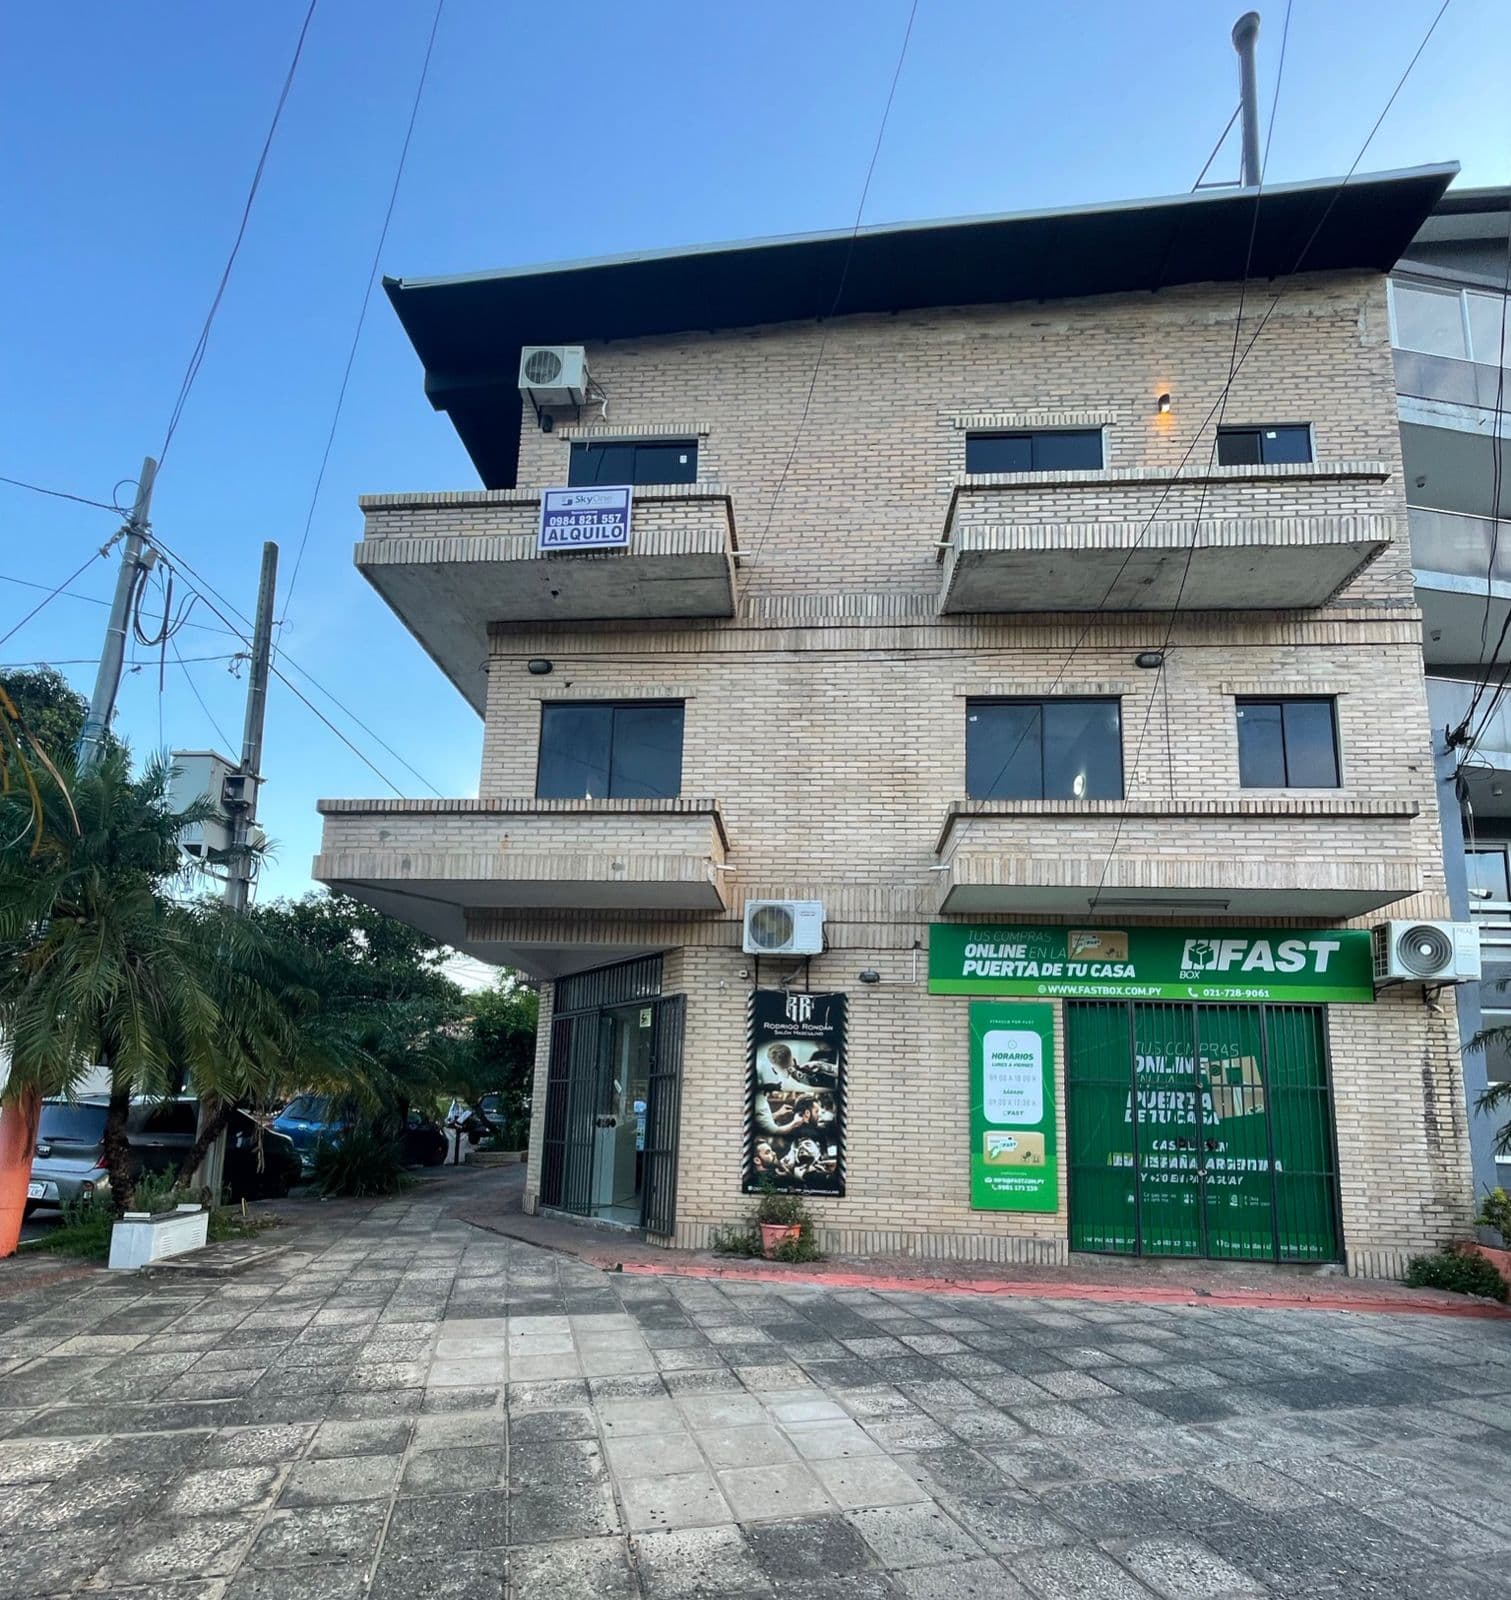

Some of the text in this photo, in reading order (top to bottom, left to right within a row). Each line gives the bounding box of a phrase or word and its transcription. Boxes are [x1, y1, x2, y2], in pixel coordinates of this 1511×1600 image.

[549, 513, 622, 526] 0984 821 557
[547, 525, 623, 542] ALQUILO
[968, 930, 1051, 943] TUS COMPRAS
[964, 944, 1067, 960] ONLINE EN LA
[1217, 939, 1341, 973] FAST
[962, 960, 1136, 978] PUERTA DE TU CASA
[1179, 971, 1200, 980] BOX
[1047, 984, 1162, 996] WWW.FASTBOX.COM.PY
[1203, 988, 1270, 998] 021-728-9061
[991, 1052, 1034, 1060] HORARIOS
[1133, 1055, 1209, 1075] ONLINE
[1126, 1090, 1213, 1110] PUERTA
[1186, 1174, 1244, 1185] PAAGUAY
